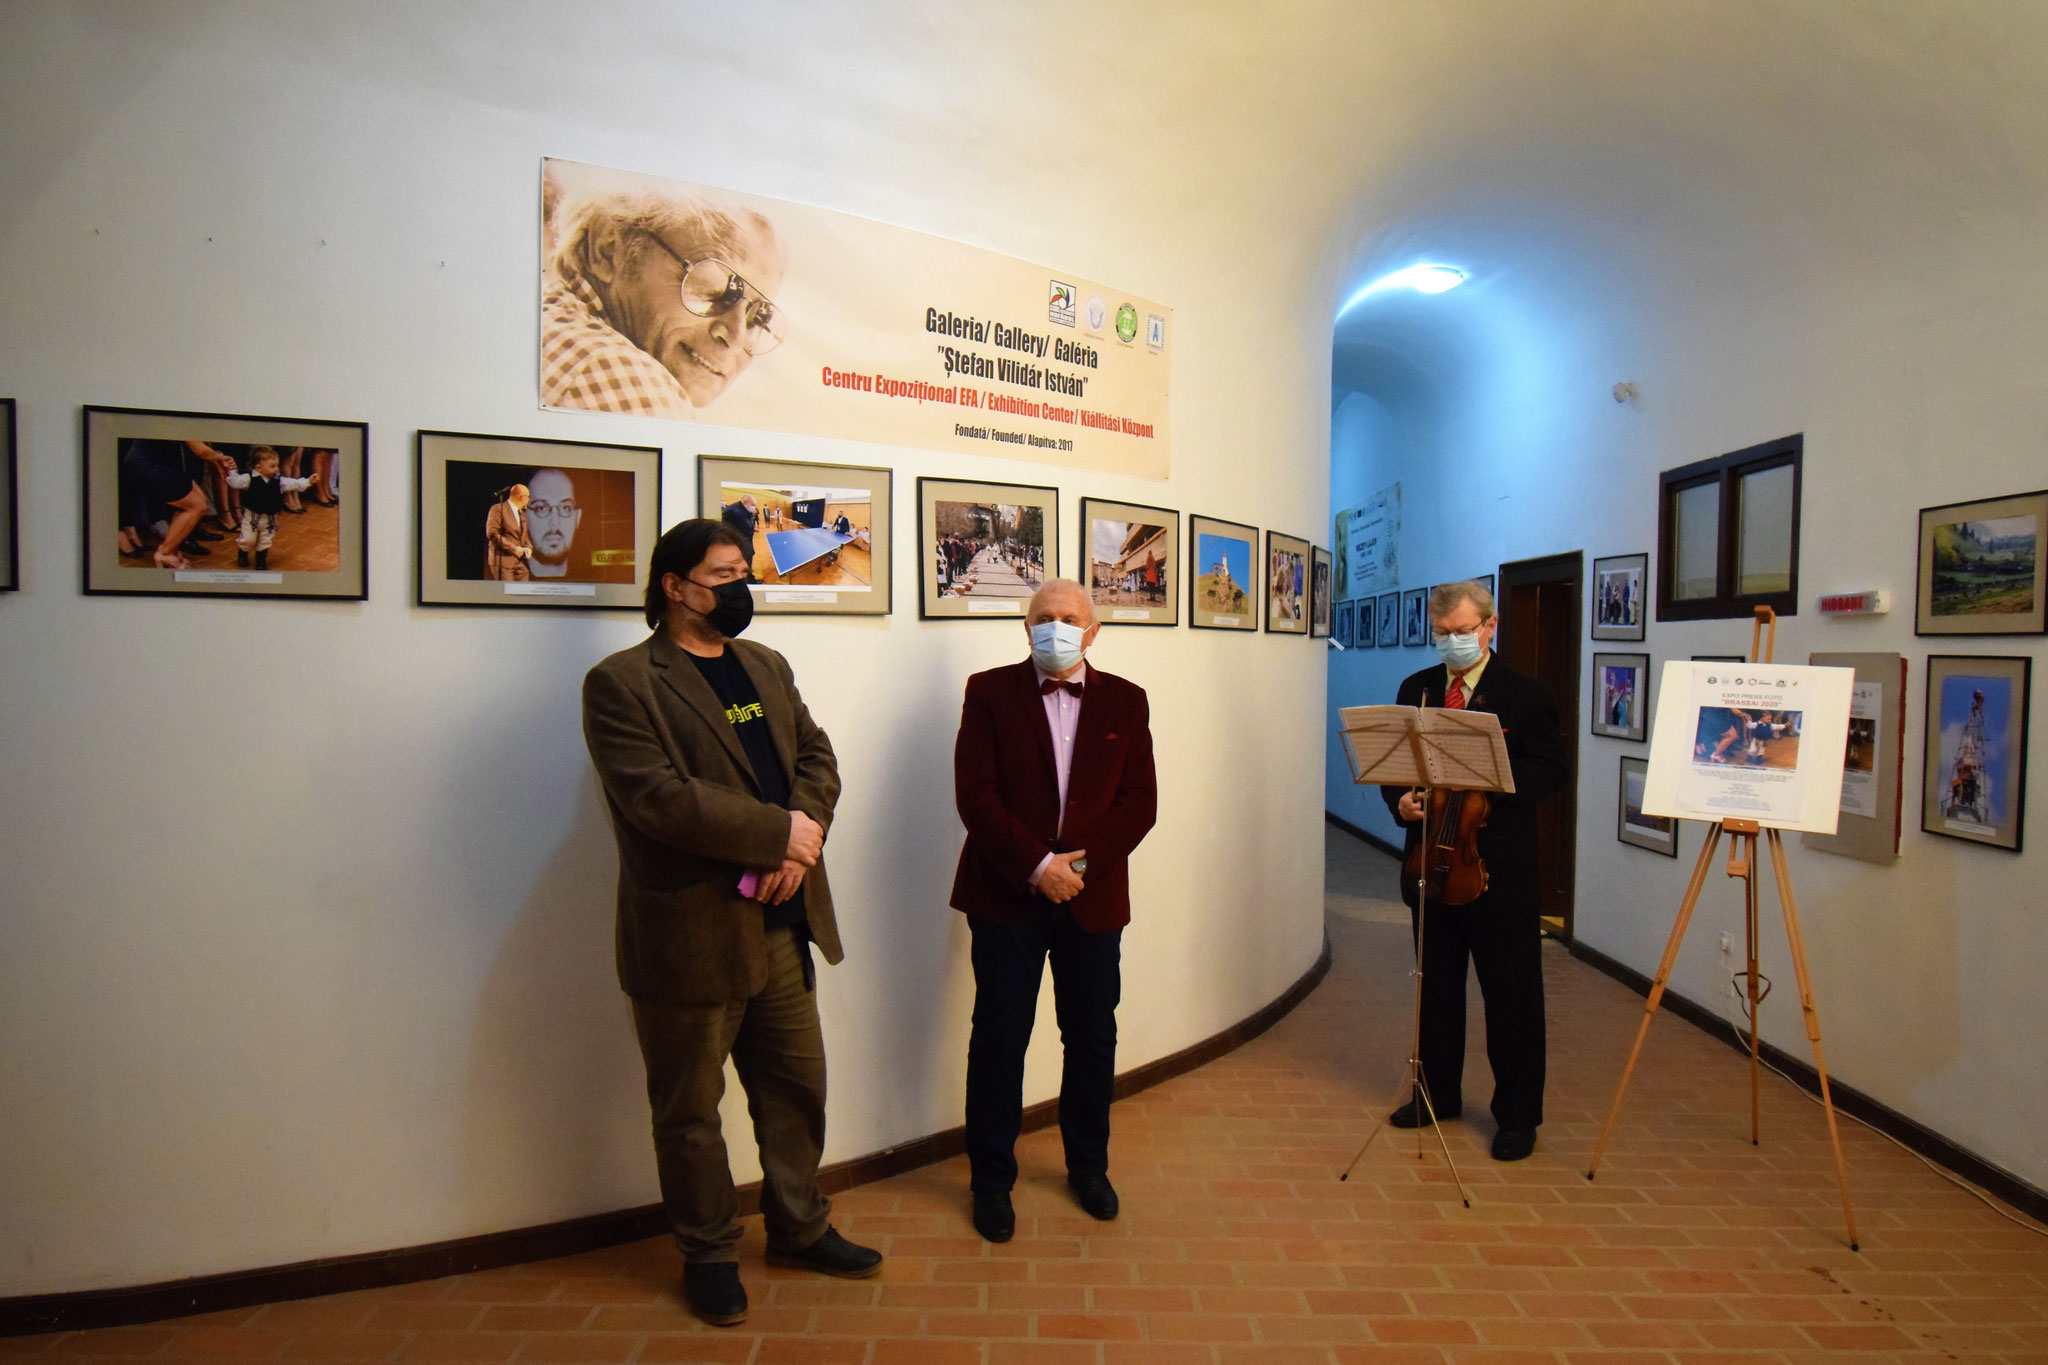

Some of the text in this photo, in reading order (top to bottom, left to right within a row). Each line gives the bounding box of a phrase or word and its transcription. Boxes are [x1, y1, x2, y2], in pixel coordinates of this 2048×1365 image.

[925, 307, 1098, 369] Galeria/ Gallery/ Galéria
[997, 357, 1042, 389] Vilidár
[822, 366, 872, 392] Centru
[959, 387, 978, 408] EFA
[988, 392, 1040, 418] Exhibition
[1042, 402, 1079, 426] Center/
[1080, 409, 1120, 433] Kiállítási
[1121, 417, 1154, 439] Központ
[991, 428, 1026, 446] Founded/
[1058, 438, 1073, 451] 2017
